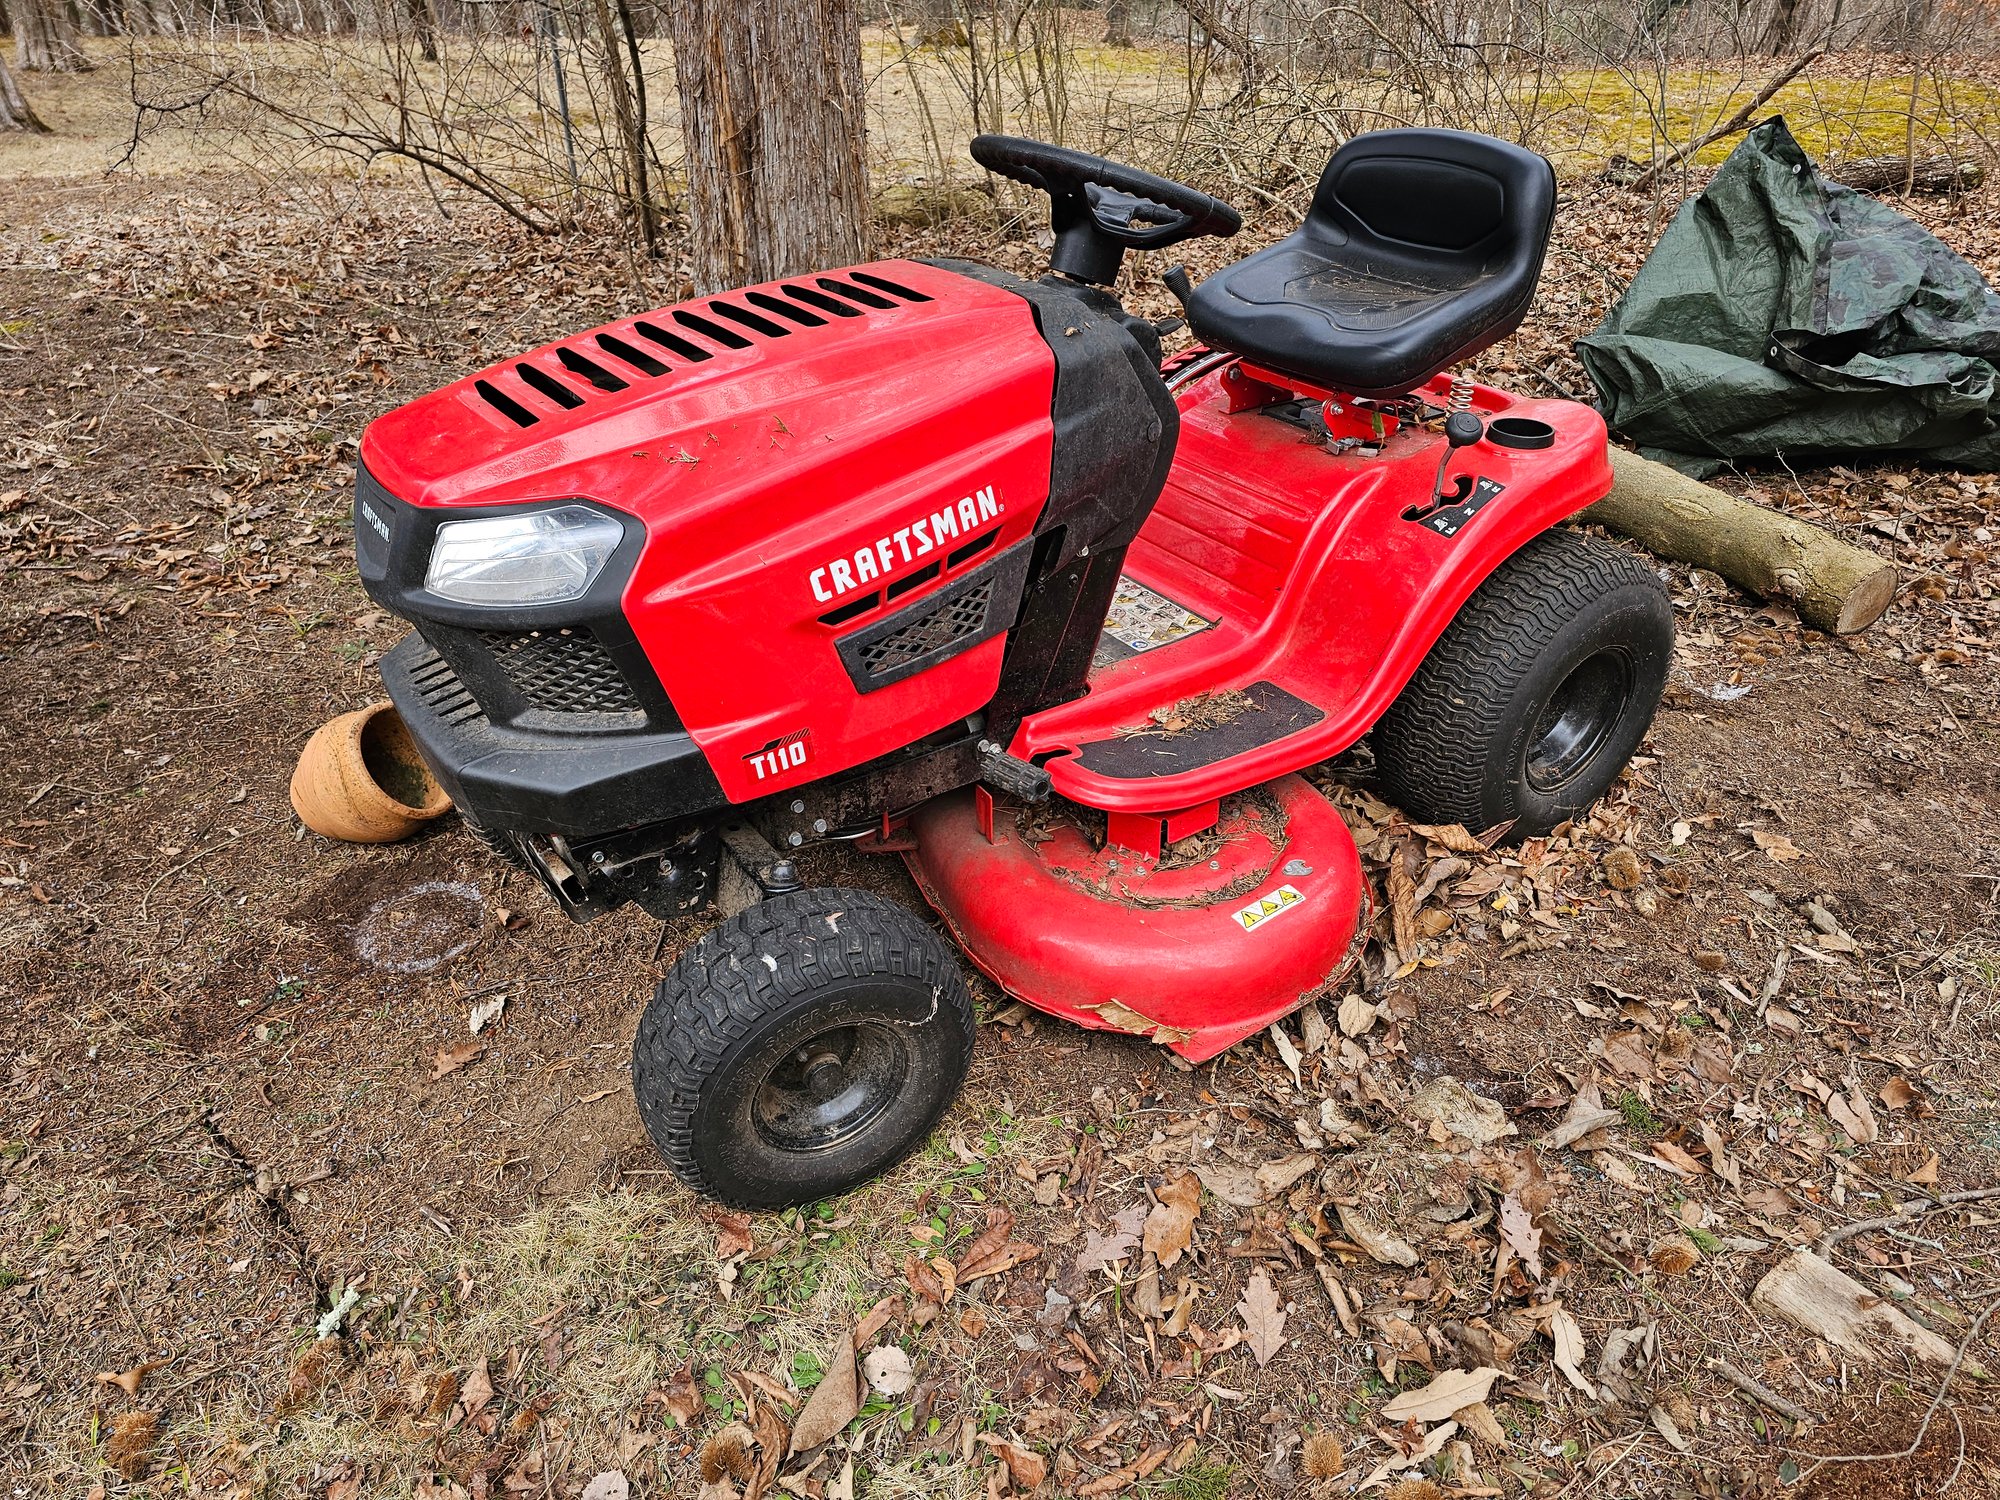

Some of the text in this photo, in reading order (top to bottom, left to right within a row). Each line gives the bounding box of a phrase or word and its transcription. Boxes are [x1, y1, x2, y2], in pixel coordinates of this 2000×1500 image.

[362, 500, 390, 542] CRAFTSMAN
[1445, 526, 1457, 535] F
[1463, 508, 1475, 516] N
[808, 484, 999, 603] CRAFTSMAN
[749, 740, 807, 780] T110
